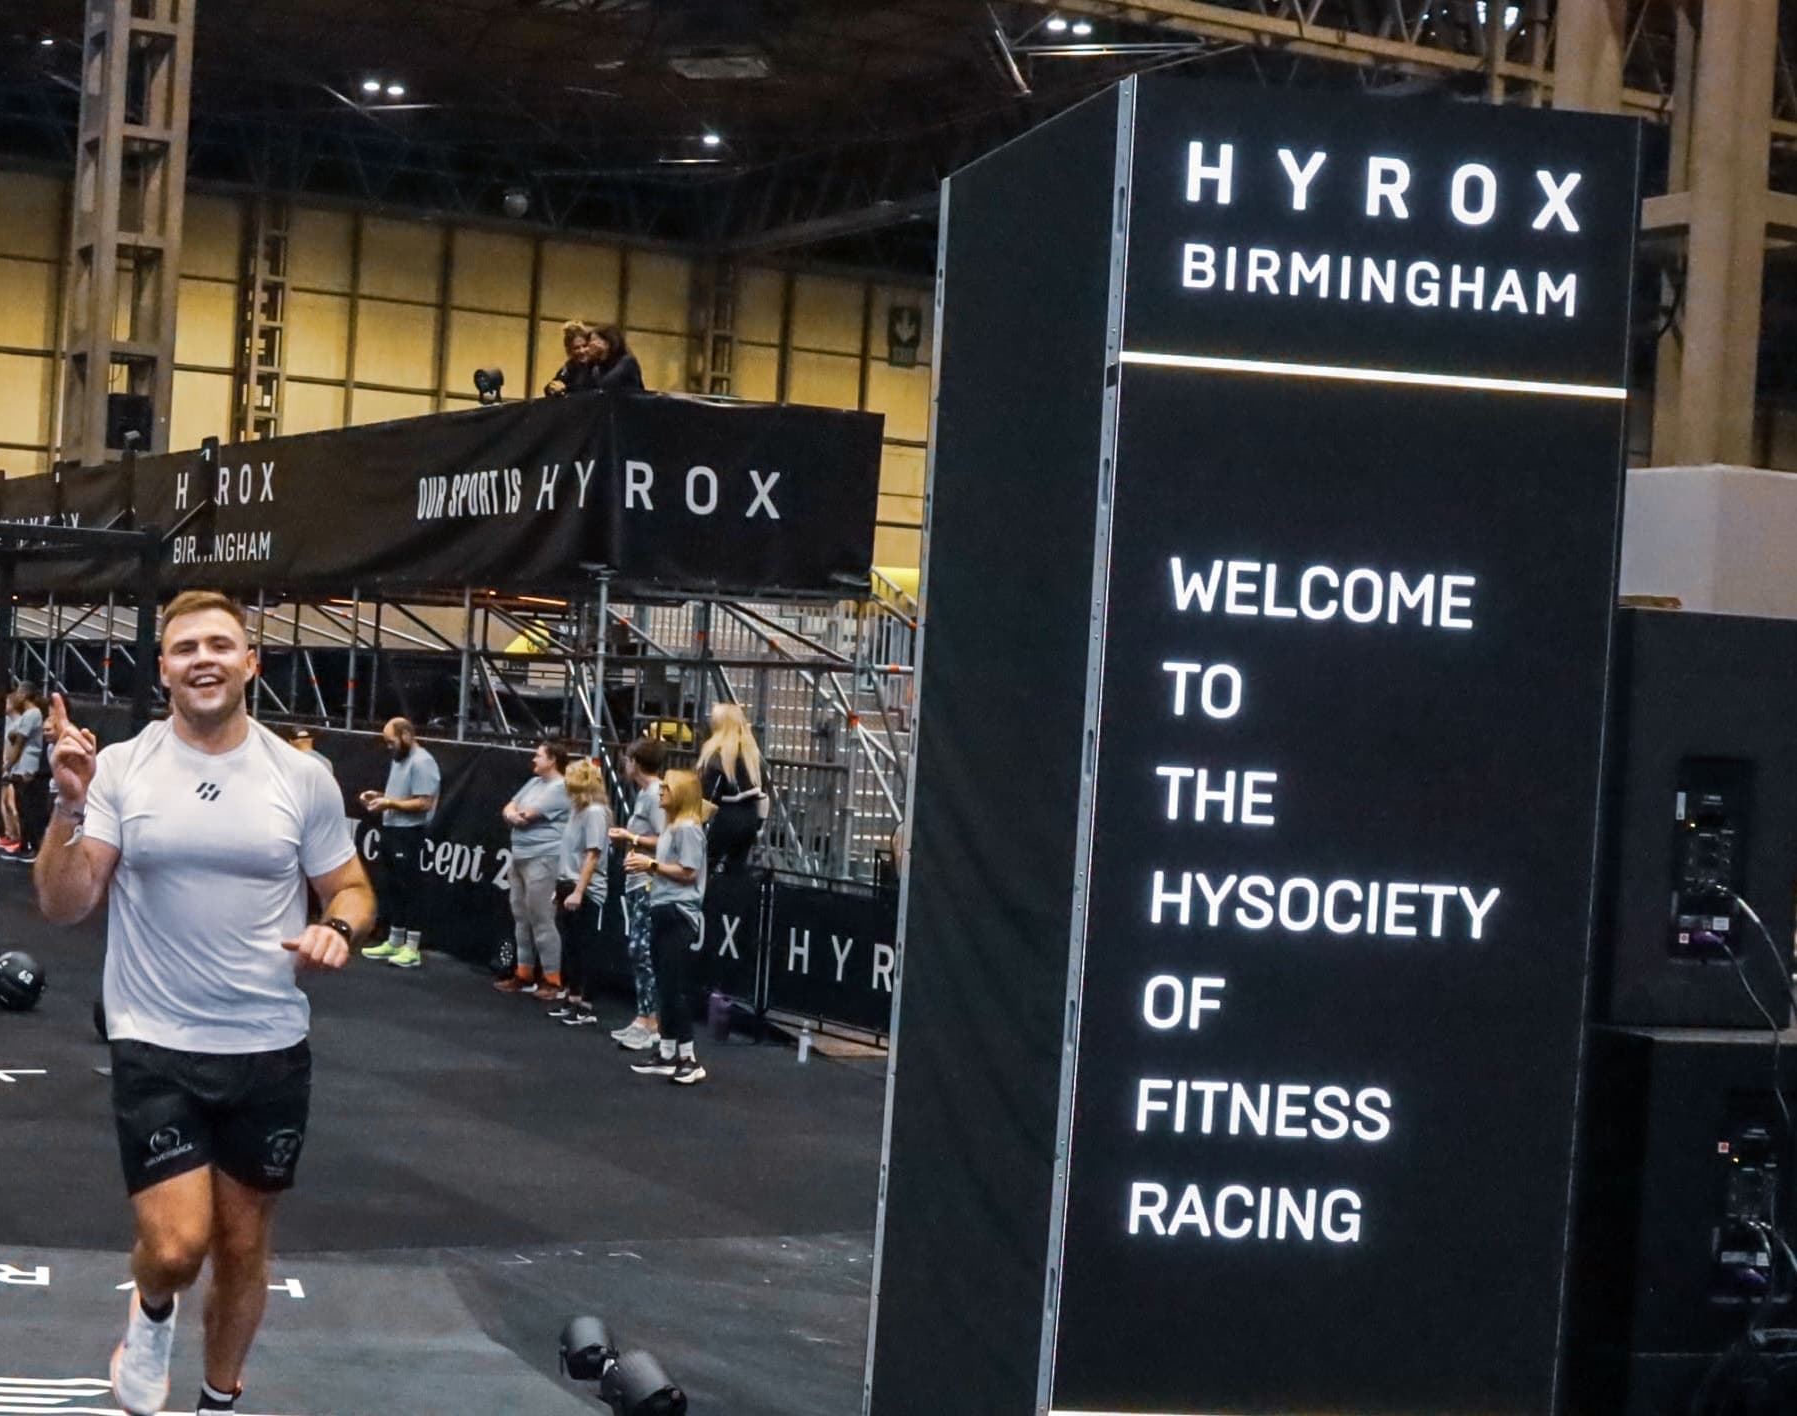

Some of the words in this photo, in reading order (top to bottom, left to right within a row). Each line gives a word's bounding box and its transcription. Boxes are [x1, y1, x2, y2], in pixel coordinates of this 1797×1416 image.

[1185, 140, 1582, 233] HYROX
[1182, 242, 1577, 318] BIRMINGHAM
[175, 461, 275, 509] HROX
[417, 476, 447, 520] OUR
[448, 469, 498, 518] SPORT
[504, 467, 522, 515] IS
[536, 459, 781, 519] HYROX
[173, 531, 272, 565] BIRNGHAM
[1169, 556, 1476, 630] WELCOME
[1162, 661, 1243, 720] TO
[1155, 765, 1278, 826] THE
[1150, 870, 1501, 940] HYSOCIETY
[1142, 974, 1226, 1031] OF
[1135, 1078, 1392, 1142] FITNESS
[1128, 1181, 1362, 1243] RACING
